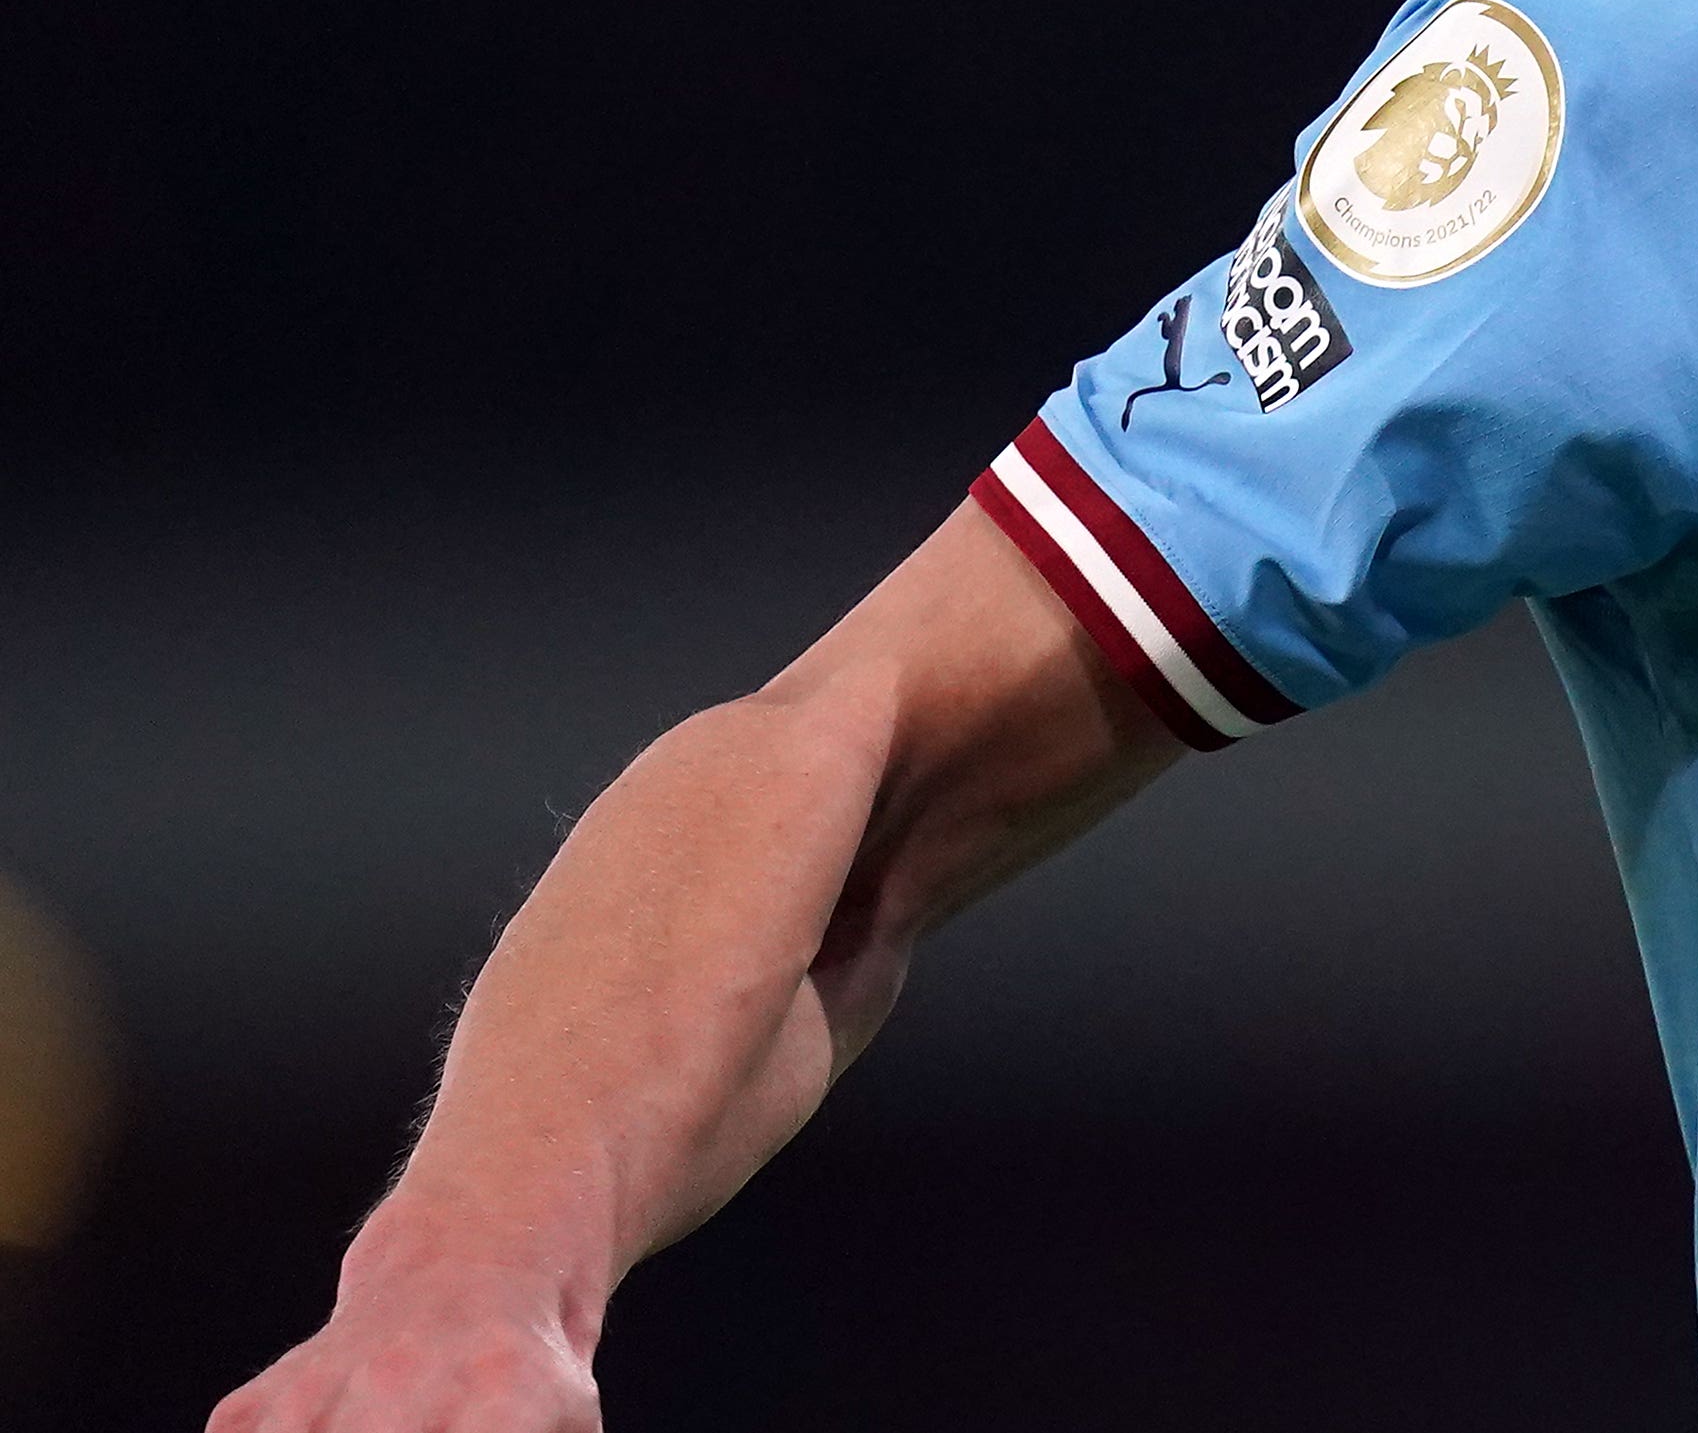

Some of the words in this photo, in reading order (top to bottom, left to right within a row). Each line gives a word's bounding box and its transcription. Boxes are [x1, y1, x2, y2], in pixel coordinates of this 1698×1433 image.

[1333, 196, 1421, 248] Champions
[1425, 189, 1498, 245] 2021/22
[1220, 279, 1300, 414] racism
[1250, 232, 1330, 371] room
